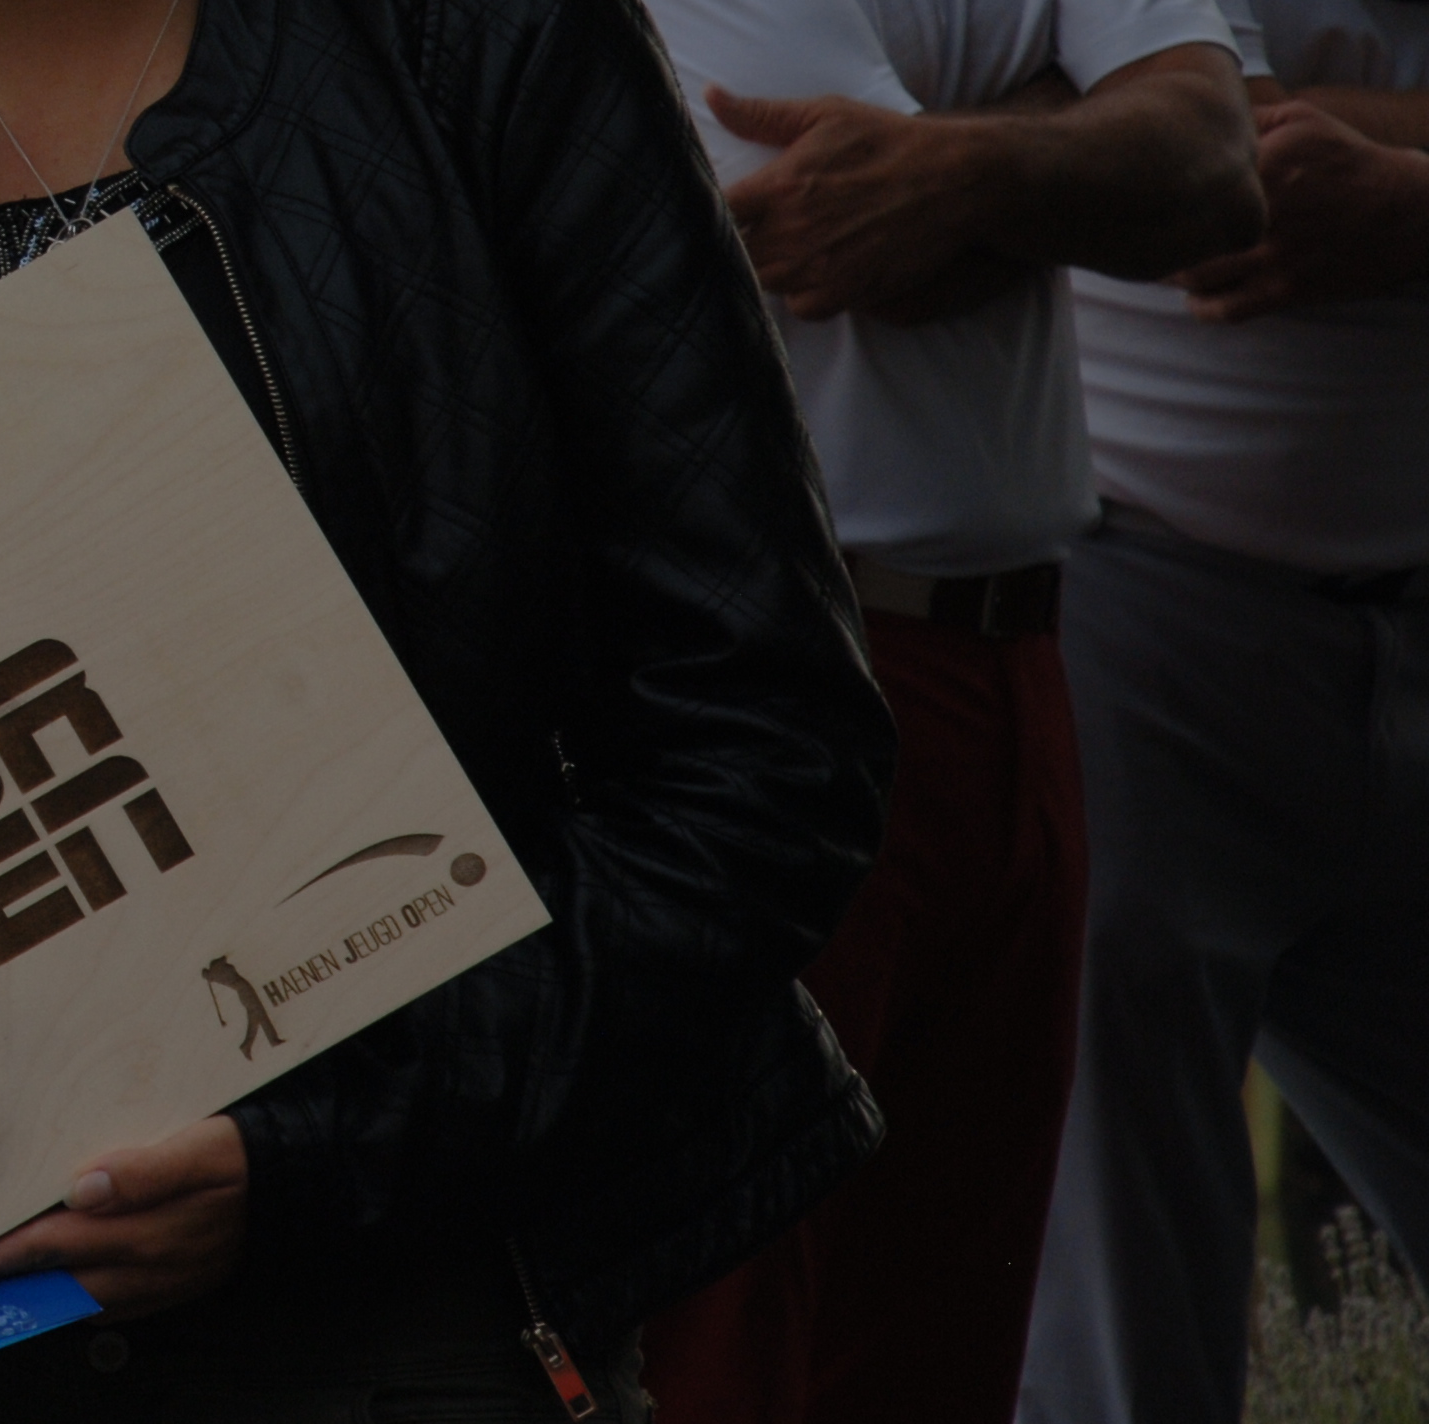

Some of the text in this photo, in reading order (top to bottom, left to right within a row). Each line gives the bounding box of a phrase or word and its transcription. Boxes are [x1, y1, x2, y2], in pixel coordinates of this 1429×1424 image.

[262, 884, 456, 1008] HAENEN JEUGD OPEN
